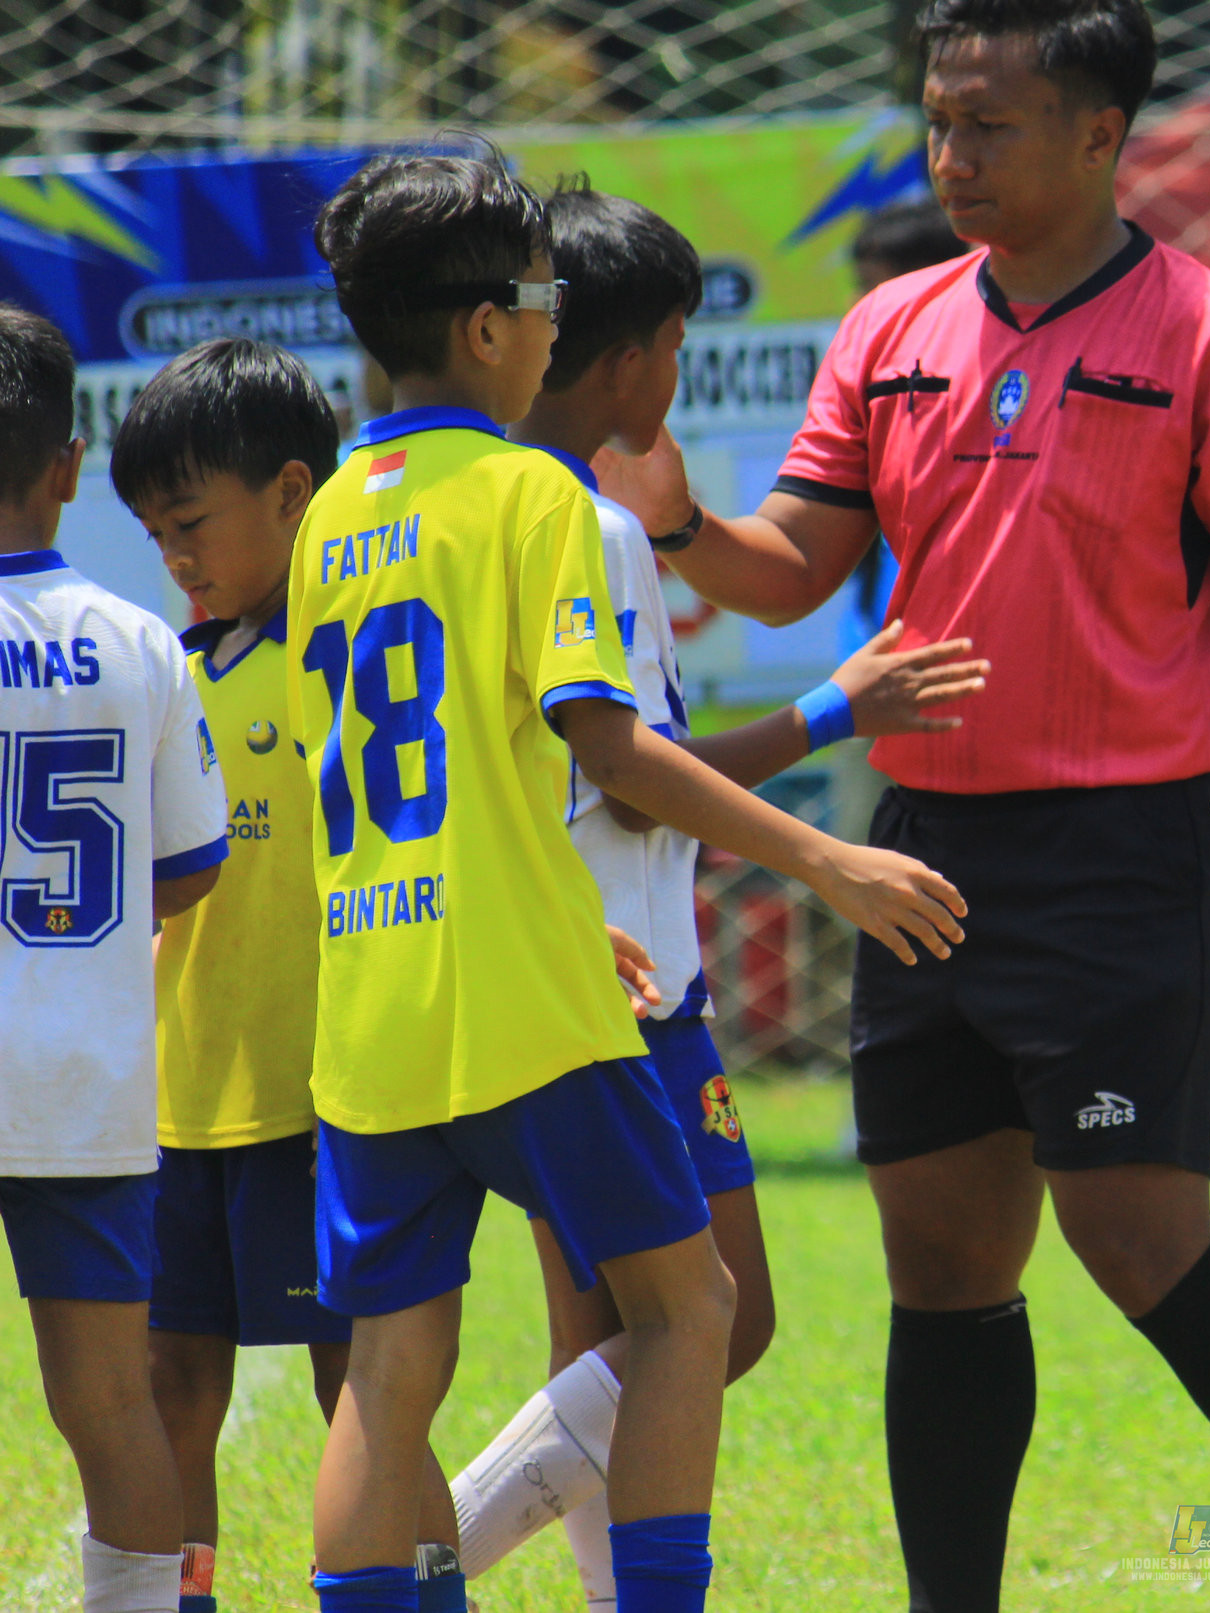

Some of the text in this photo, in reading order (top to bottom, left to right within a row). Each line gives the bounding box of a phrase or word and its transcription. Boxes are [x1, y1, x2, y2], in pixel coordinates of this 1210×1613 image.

[321, 514, 420, 584] FATTAN
[302, 597, 448, 857] 18
[0, 728, 125, 948] 5
[1077, 1107, 1136, 1129] SPECS
